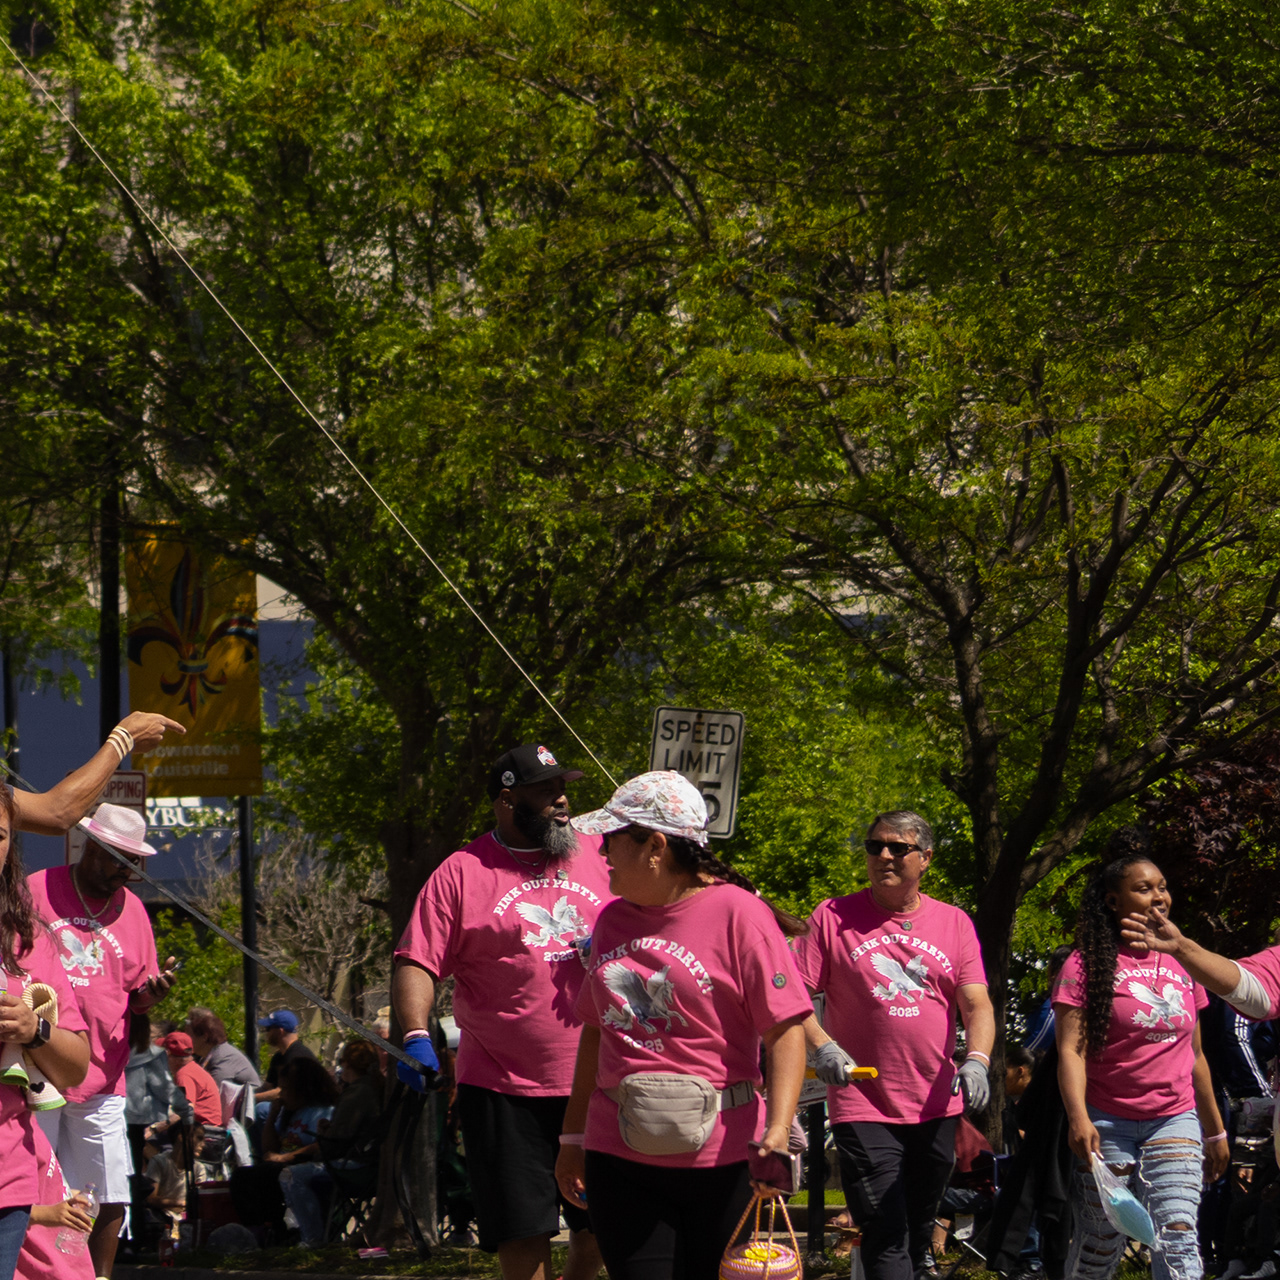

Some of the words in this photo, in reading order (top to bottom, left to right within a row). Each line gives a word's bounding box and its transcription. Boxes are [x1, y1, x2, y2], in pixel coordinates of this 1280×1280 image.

[660, 718, 736, 746] SPEED
[143, 760, 229, 778] Louisville
[663, 748, 727, 775] LIMIT
[698, 781, 722, 825] 5
[493, 884, 522, 917] PINK
[521, 877, 550, 892] OUT
[553, 878, 602, 907] PARTY!
[99, 926, 124, 959] ARTY!
[543, 949, 575, 962] 2025
[850, 937, 880, 962] PINK
[881, 933, 910, 944] OUT
[911, 937, 953, 974] PARTY!
[630, 937, 667, 952] OUT
[665, 941, 715, 995] PARTY!
[889, 1006, 921, 1018] 2025
[1145, 1032, 1178, 1043] 2025
